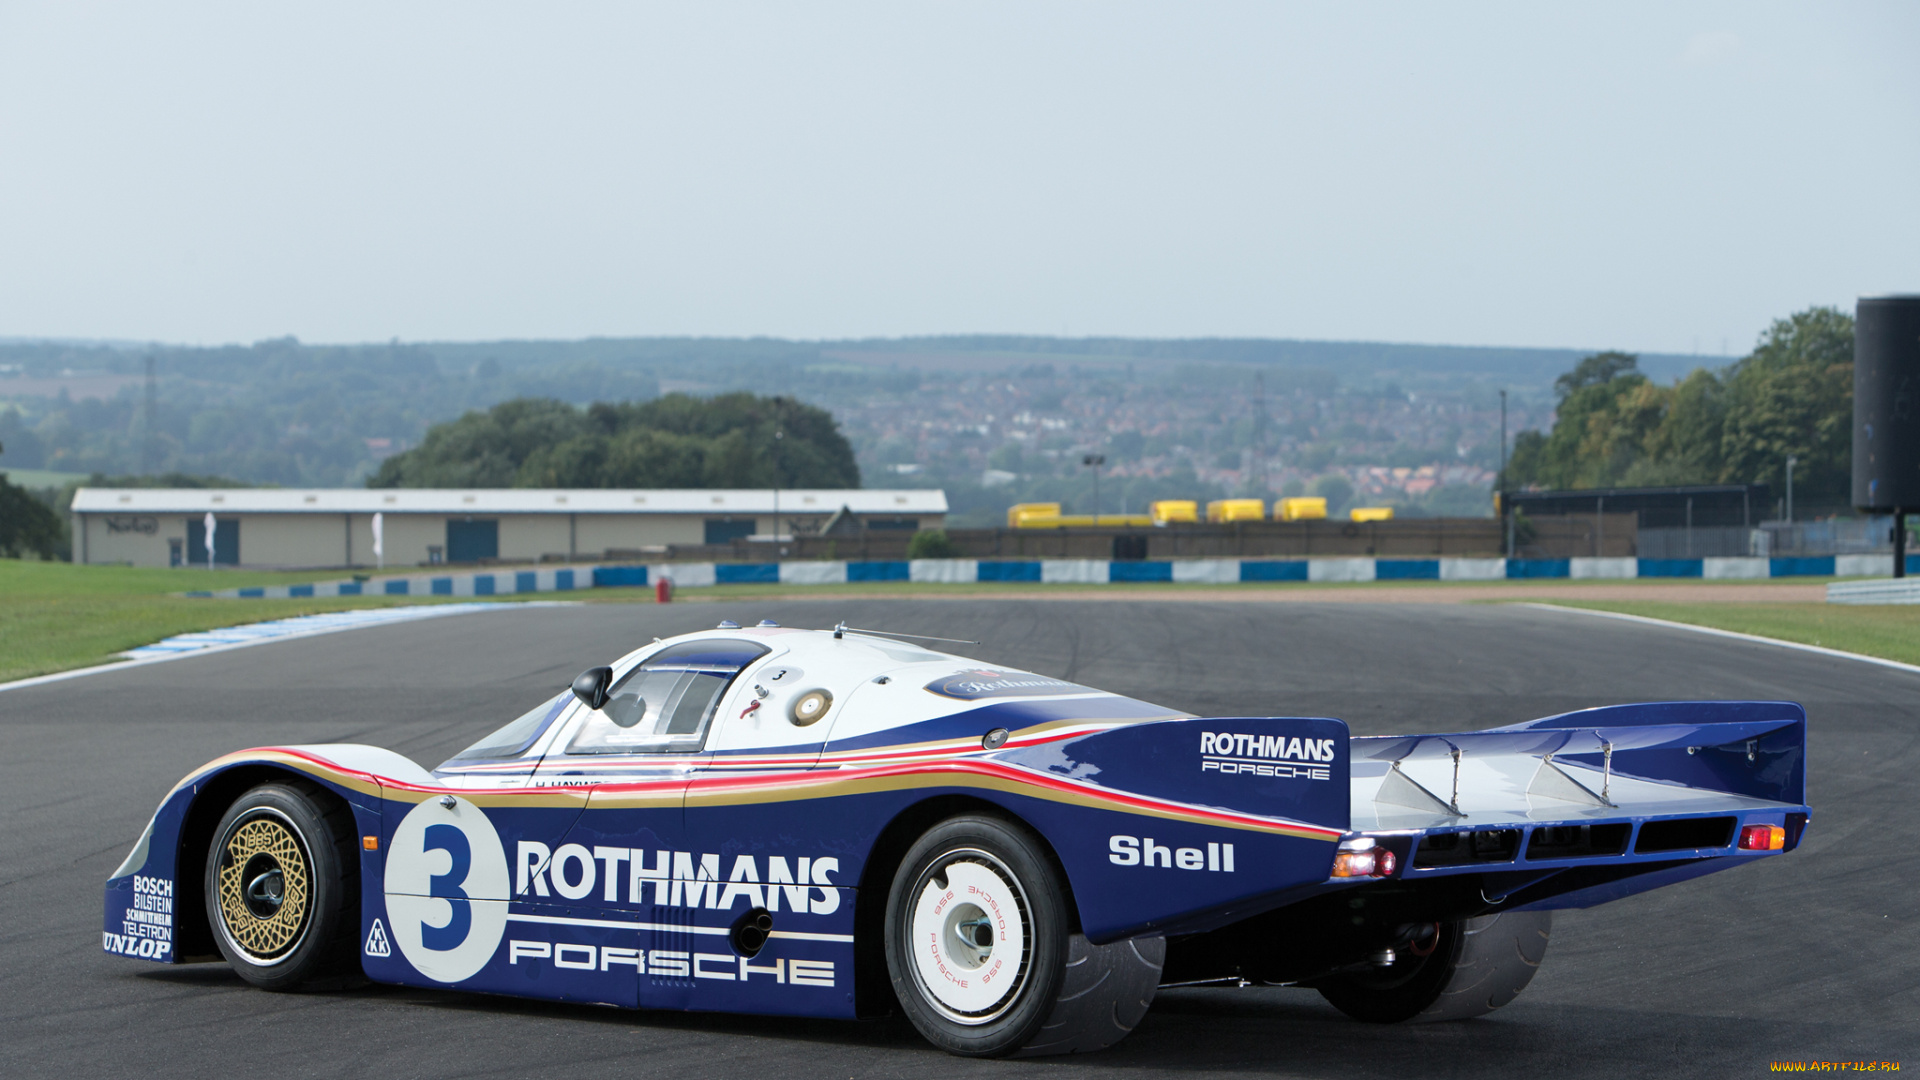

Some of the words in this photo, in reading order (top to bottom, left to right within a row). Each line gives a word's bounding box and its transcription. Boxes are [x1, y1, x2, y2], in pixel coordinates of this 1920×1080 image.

[772, 669, 787, 680] 3
[1200, 731, 1335, 761] ROTHMANS
[1202, 761, 1330, 780] PORSCHE
[247, 832, 272, 847] BBS
[1109, 835, 1235, 872] Shell
[133, 874, 173, 897] BOSCH
[420, 824, 472, 952] 3
[516, 840, 841, 915] ROTHMANS
[134, 892, 172, 914] BILSTEIN
[934, 890, 955, 916] 956
[967, 885, 1007, 941] PORSCHE
[122, 920, 172, 941] TELETRON
[374, 927, 382, 941] K
[102, 930, 172, 959] UNLOP
[509, 940, 835, 987] PORSCHE
[930, 932, 969, 989] PORSCHE
[982, 958, 1003, 984] 956
